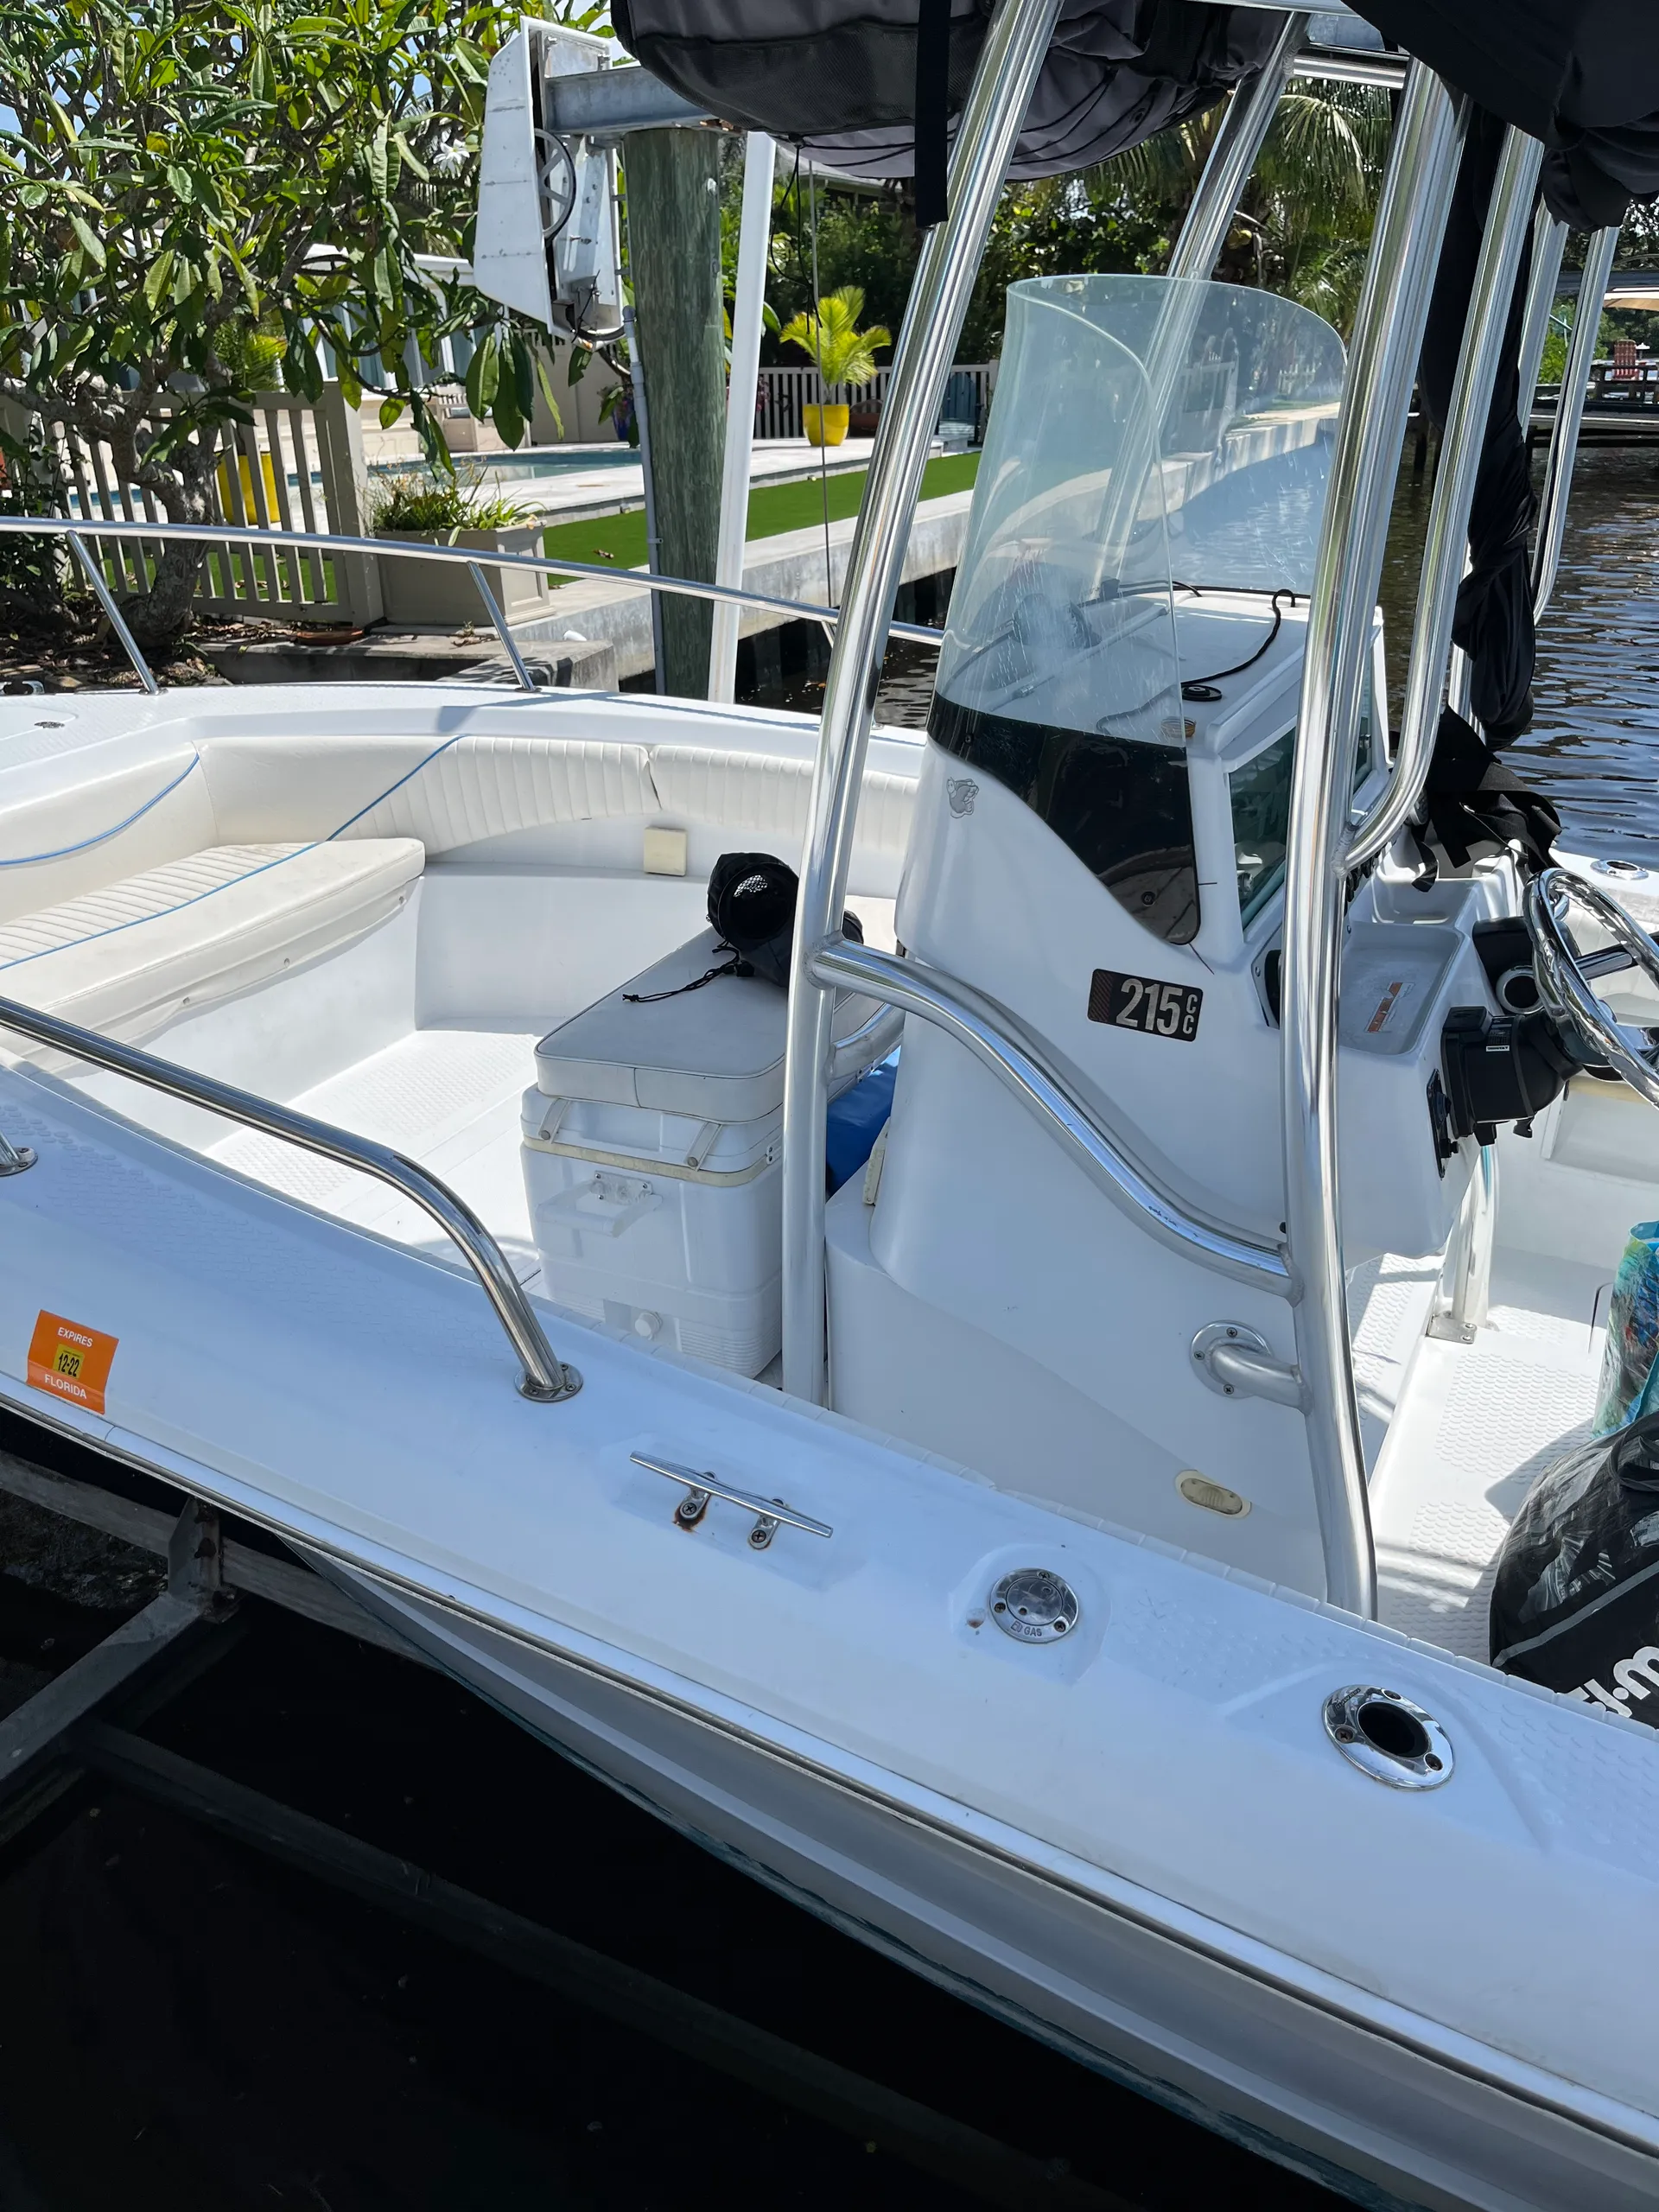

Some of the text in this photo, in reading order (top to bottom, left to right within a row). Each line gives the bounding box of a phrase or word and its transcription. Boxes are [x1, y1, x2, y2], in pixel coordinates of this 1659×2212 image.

[1116, 978, 1183, 1035] 215
[57, 1326, 93, 1348] EXPIRES
[58, 1352, 79, 1377] 12-22
[44, 1374, 87, 1399] FLORIDA
[1024, 1626, 1042, 1637] GAS
